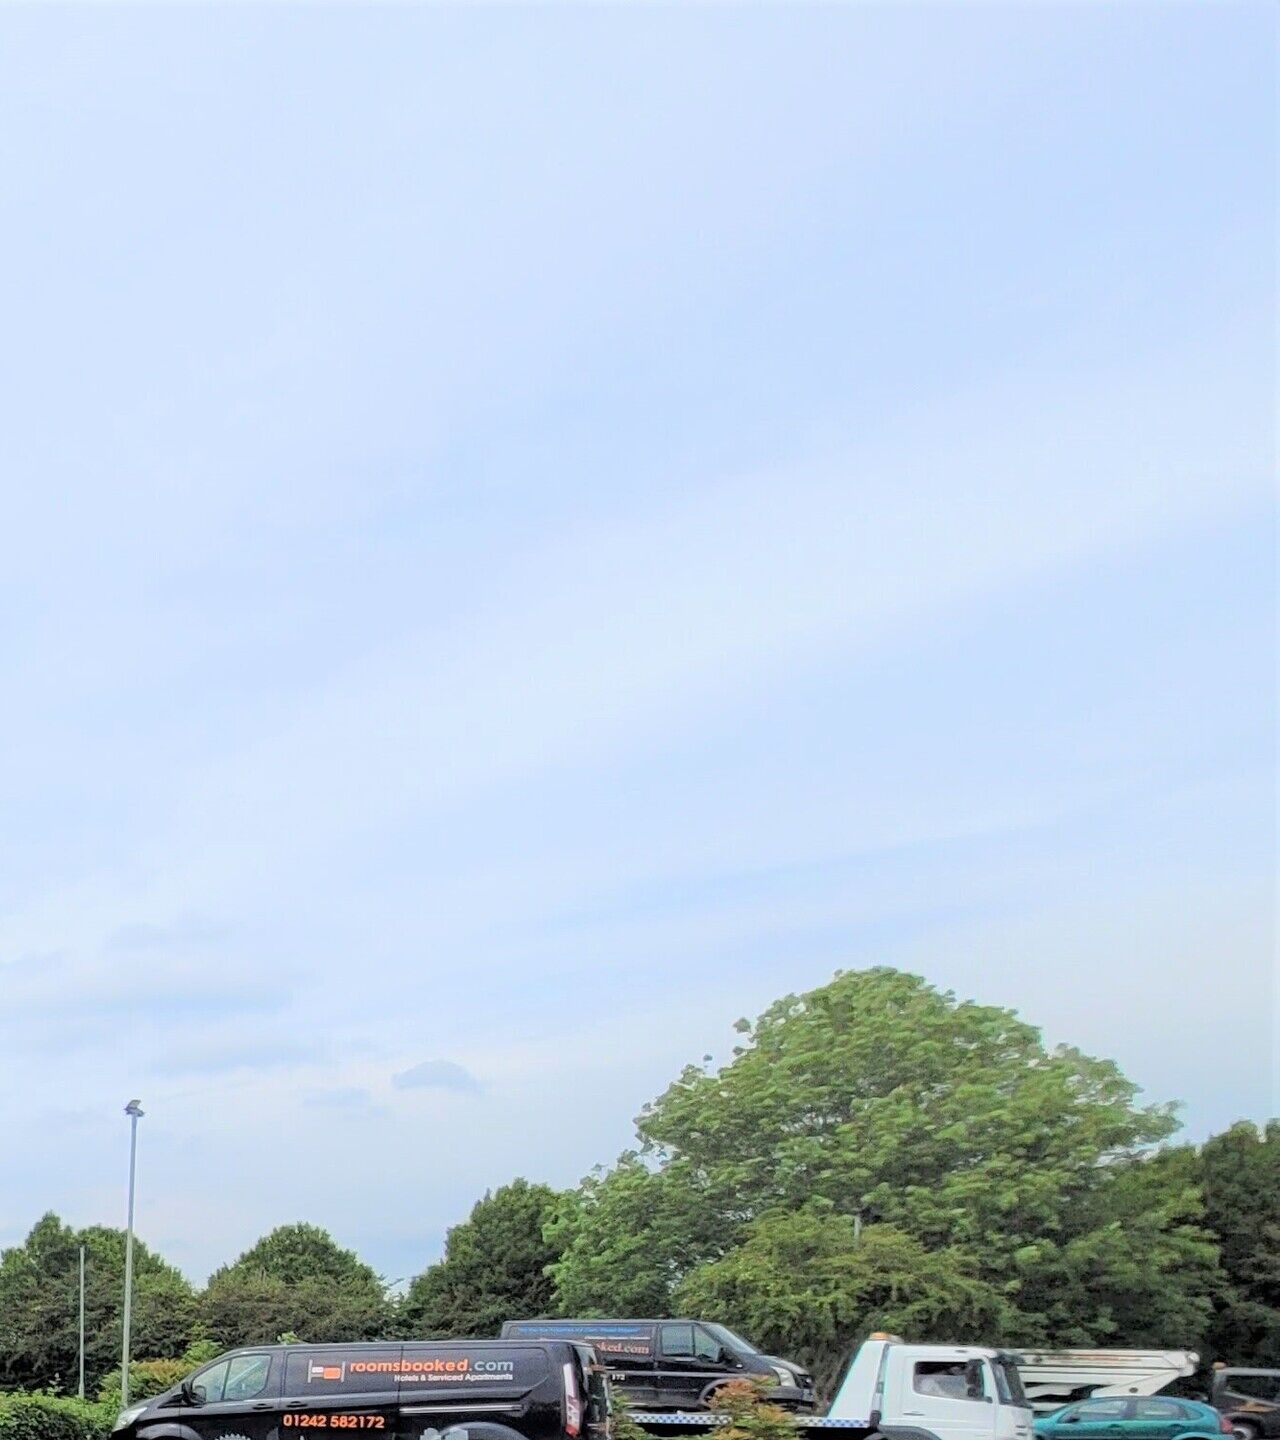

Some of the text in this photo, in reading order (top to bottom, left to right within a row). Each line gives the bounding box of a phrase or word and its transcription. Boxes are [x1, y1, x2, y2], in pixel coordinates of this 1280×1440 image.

[597, 1341, 650, 1354] ked.com
[350, 1359, 514, 1372] roomsbooked.com
[394, 1374, 419, 1382] Hotels
[428, 1373, 464, 1381] Serviced
[465, 1373, 513, 1381] Apartments
[283, 1414, 385, 1428] 01242 582172
